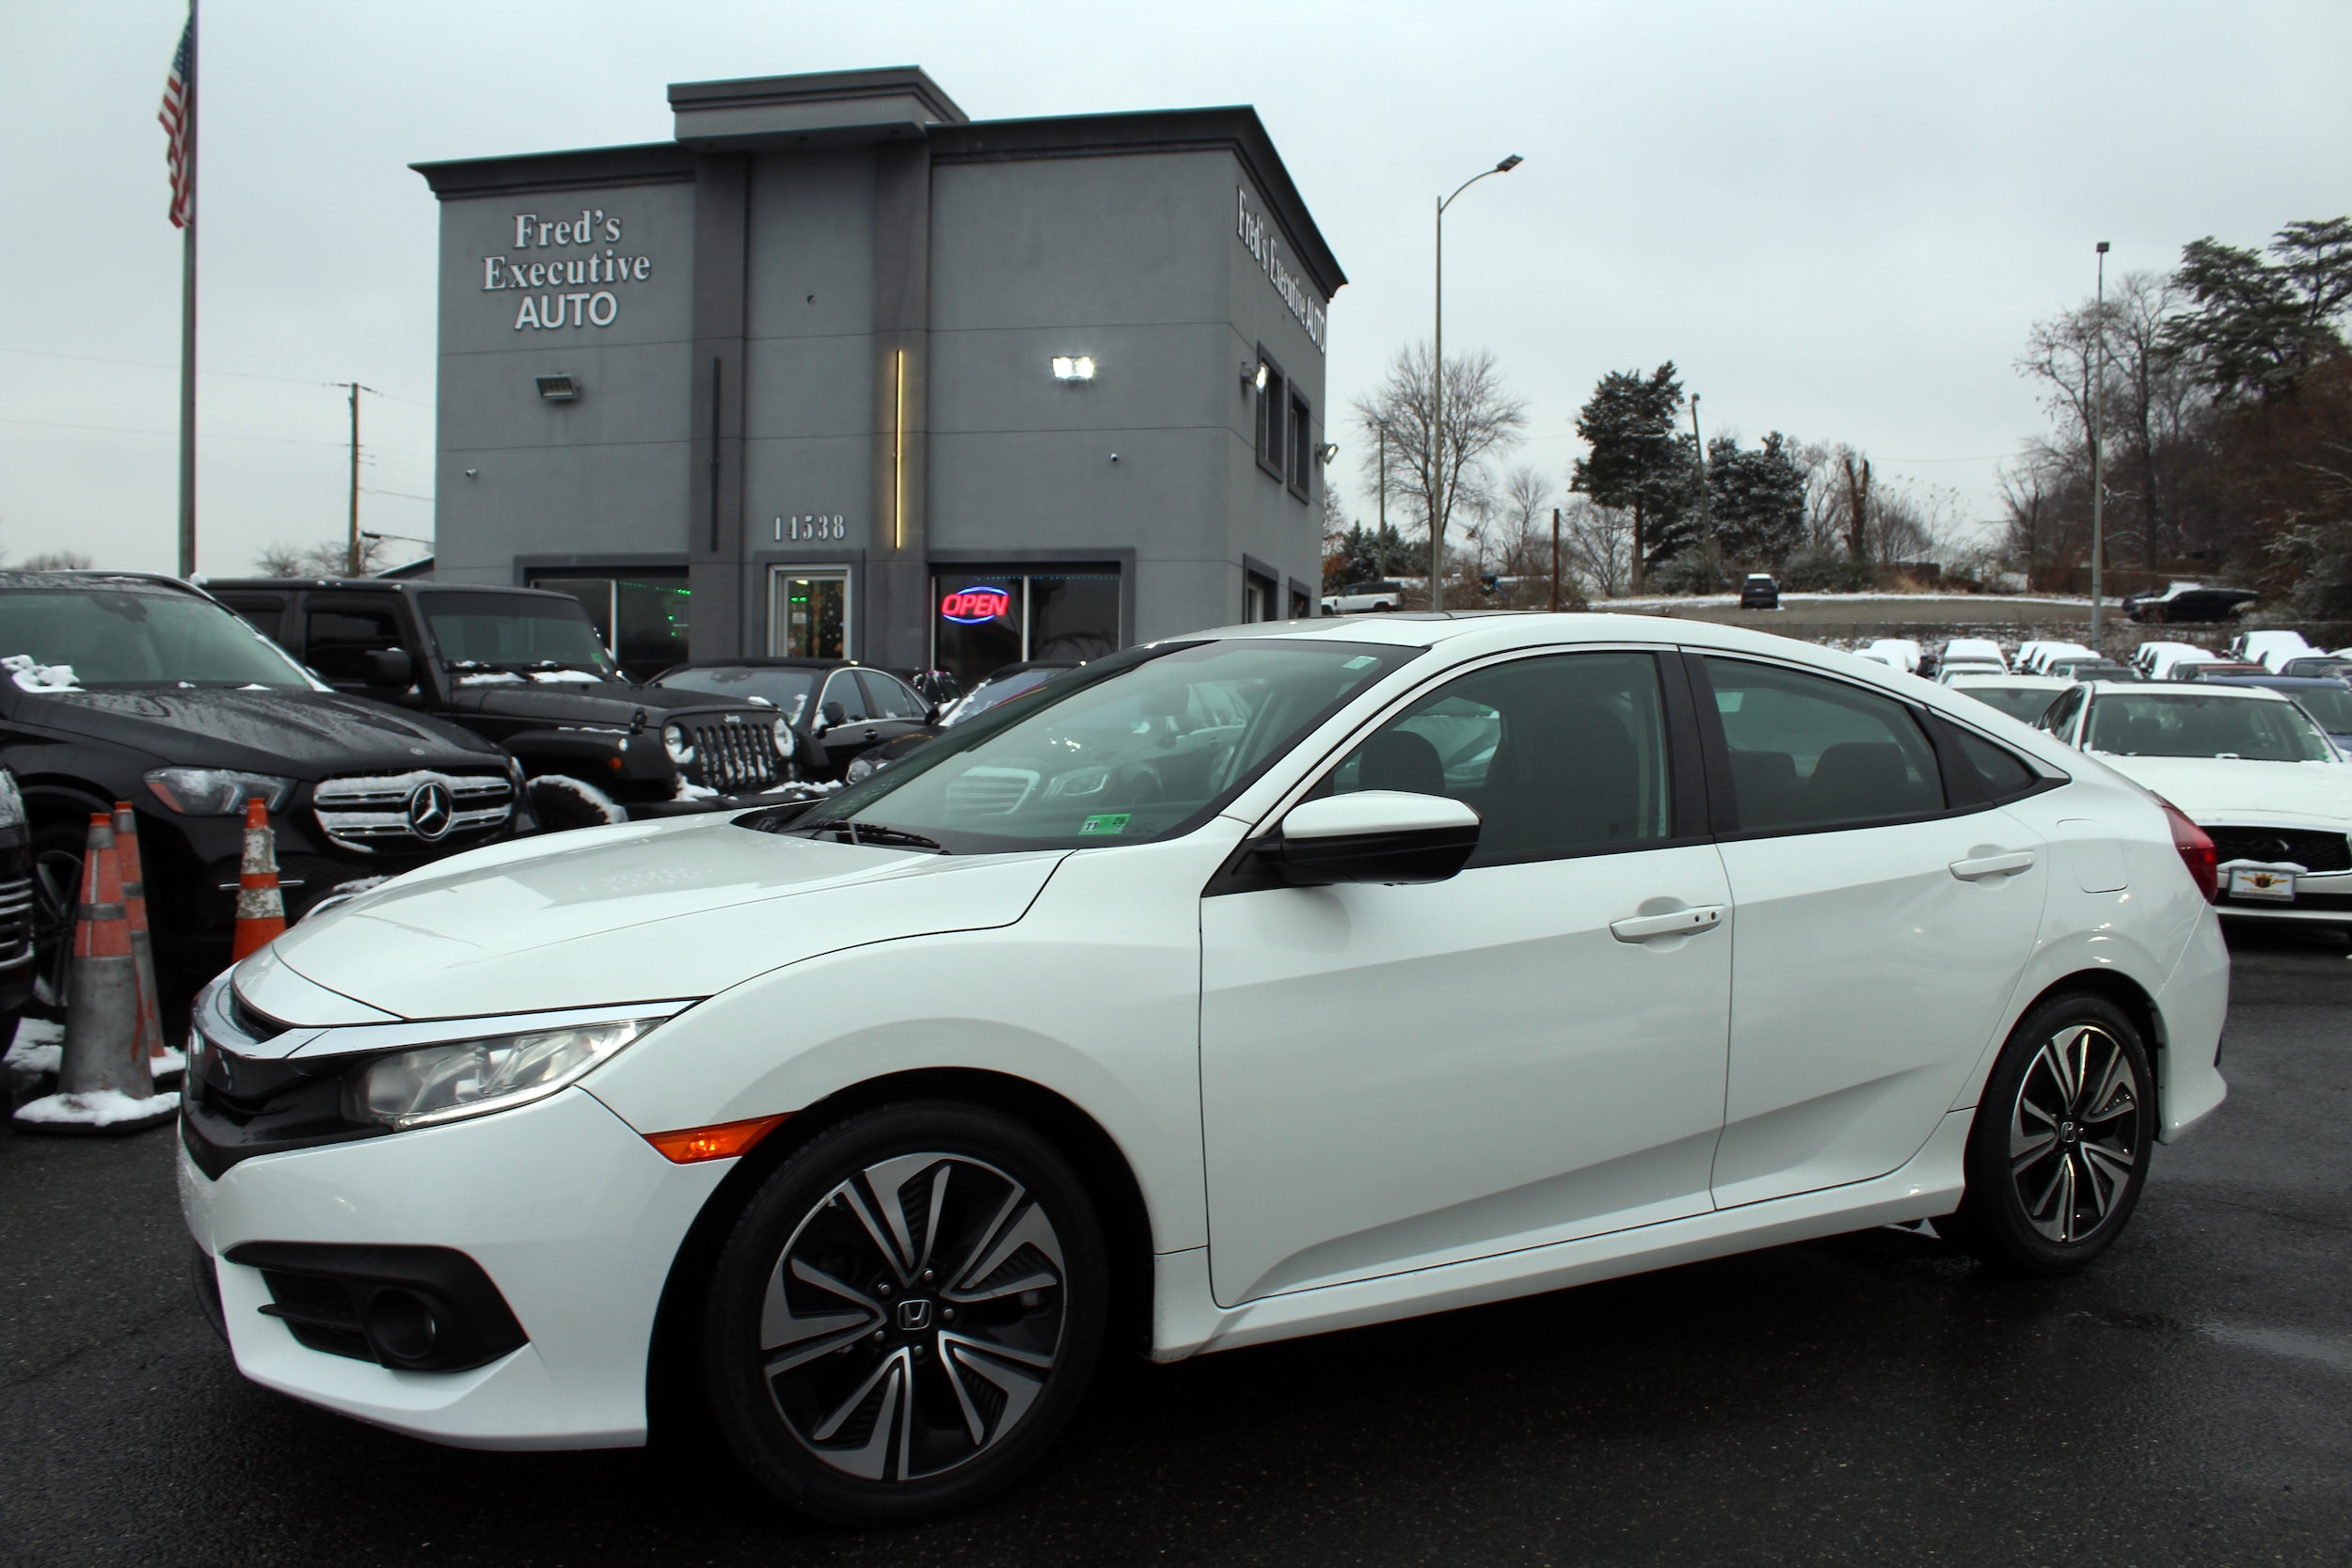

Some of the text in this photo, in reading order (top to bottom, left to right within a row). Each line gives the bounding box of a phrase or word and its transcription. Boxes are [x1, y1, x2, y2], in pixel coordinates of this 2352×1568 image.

[513, 208, 622, 249] Fred's
[482, 247, 652, 291] Executive
[1237, 186, 1327, 354] Fred's Executive AUTO
[514, 290, 618, 330] AUTO
[774, 514, 846, 541] 14538
[941, 593, 1010, 617] OPEN
[1085, 821, 1099, 831] 11
